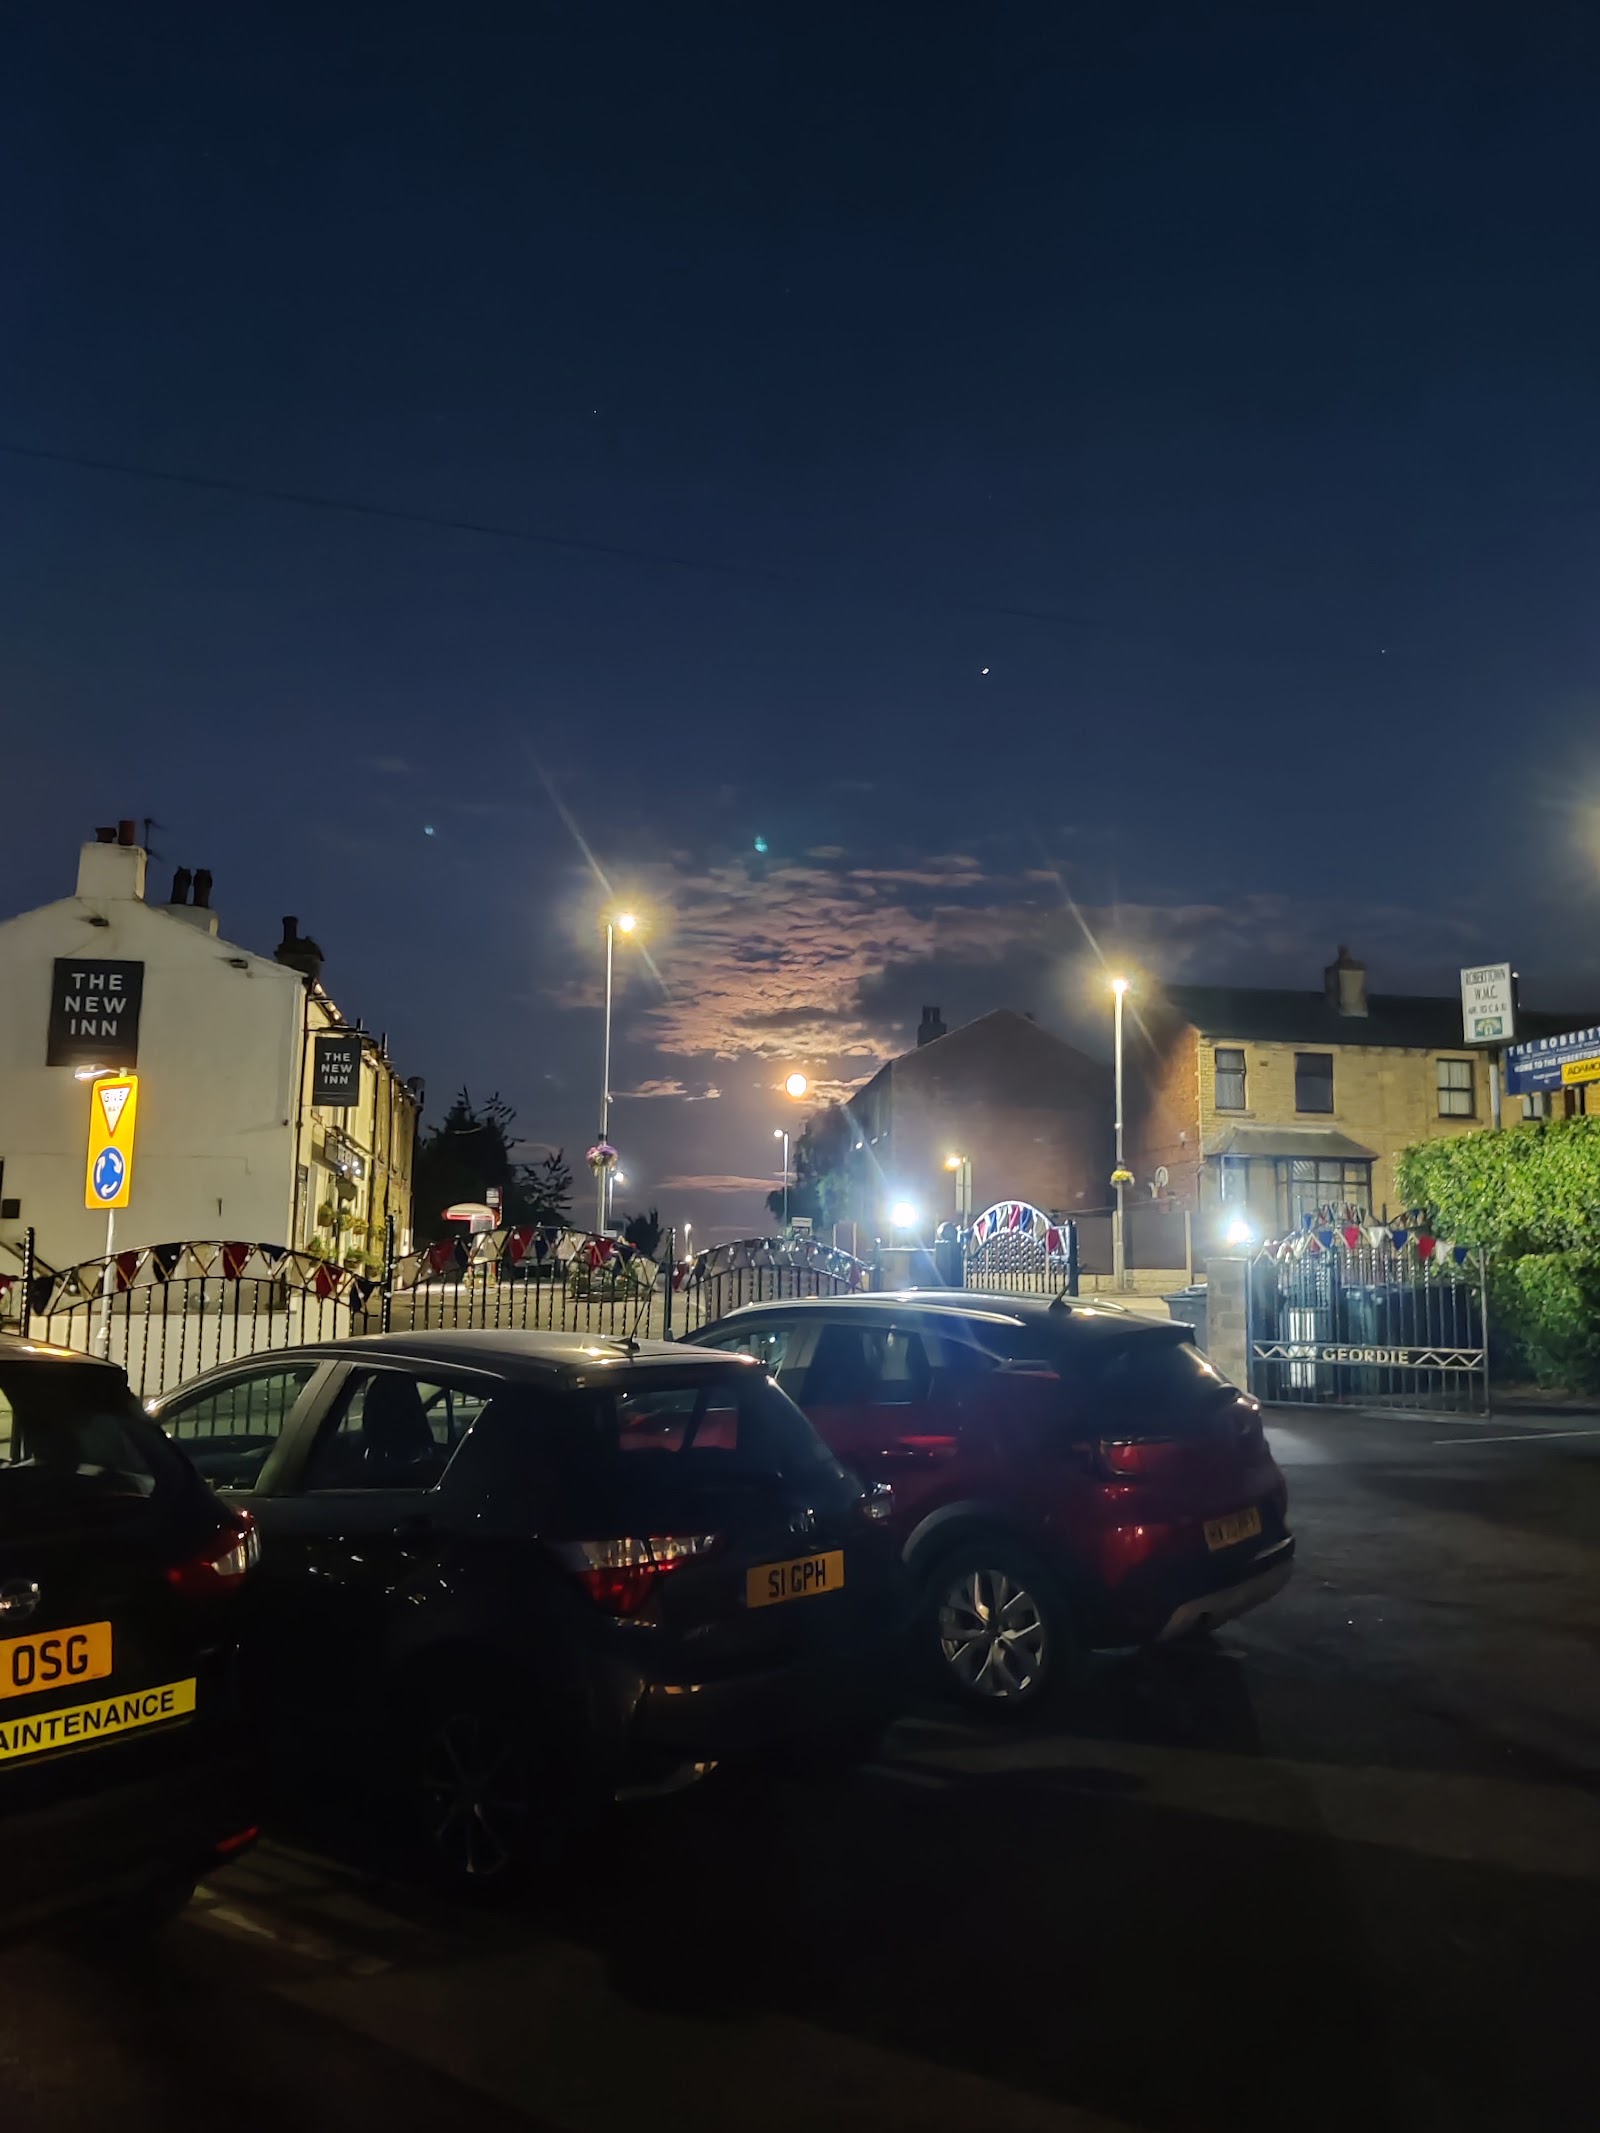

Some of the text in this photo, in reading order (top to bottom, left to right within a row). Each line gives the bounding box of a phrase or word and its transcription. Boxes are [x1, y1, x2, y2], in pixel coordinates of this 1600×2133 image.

[72, 973, 123, 990] THE
[64, 995, 127, 1014] NEW
[70, 1019, 117, 1036] INN
[324, 1052, 351, 1062] THE
[1508, 1042, 1533, 1057] THE
[321, 1063, 353, 1073] NEW
[324, 1075, 349, 1085] INN
[1322, 1347, 1409, 1365] GEORDIE
[792, 1559, 826, 1592] GPH
[12, 1634, 88, 1687] OSG
